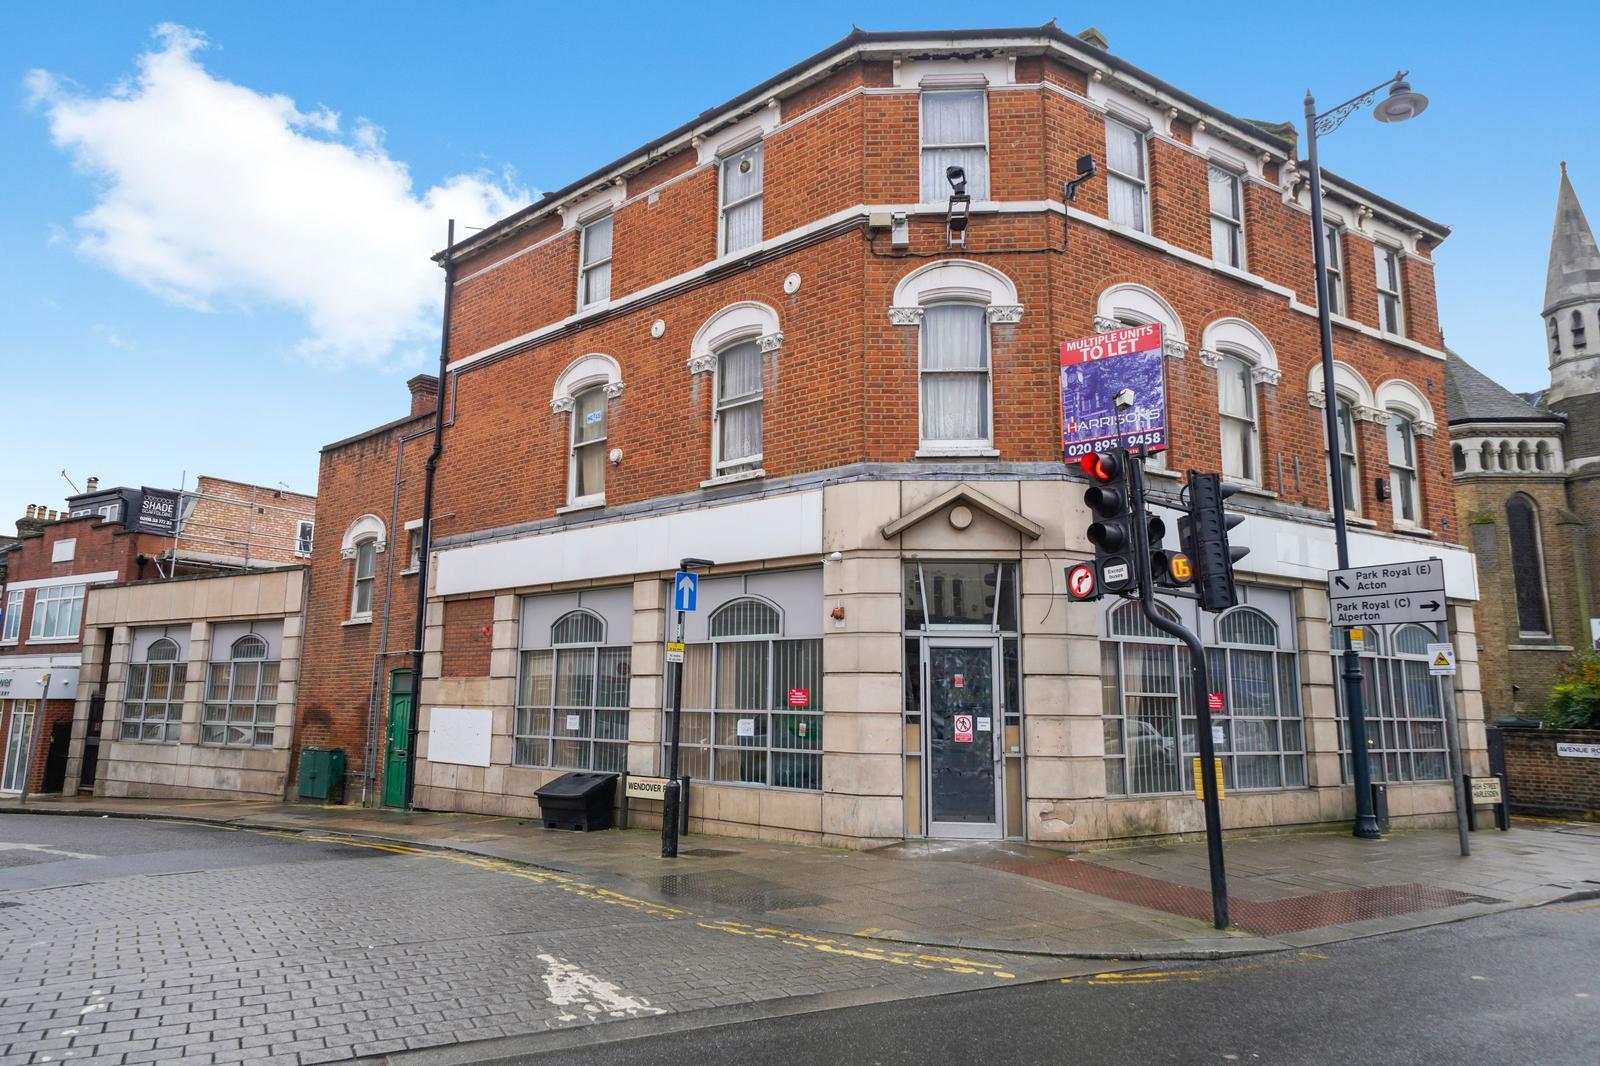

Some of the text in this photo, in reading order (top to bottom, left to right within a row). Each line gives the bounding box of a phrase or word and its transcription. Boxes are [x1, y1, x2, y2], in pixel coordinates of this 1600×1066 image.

[1066, 325, 1153, 352] MULTIPLE UNITS
[1080, 338, 1138, 362] TO LET
[1067, 408, 1160, 434] HARRISONS
[1068, 443, 1092, 456] 020
[1094, 438, 1120, 452] 895
[1127, 432, 1161, 447] 9458
[143, 501, 174, 513] SHADE
[1107, 567, 1124, 576] Except
[1355, 564, 1431, 580] Park Royal (E)
[1357, 581, 1387, 590] Acton
[1336, 597, 1411, 612] Park Royal (C)
[1338, 611, 1380, 623] Alperton
[1559, 746, 1589, 754] AVENUE
[628, 782, 661, 792] WENDOVER
[1474, 790, 1499, 798] HARLESDEN
